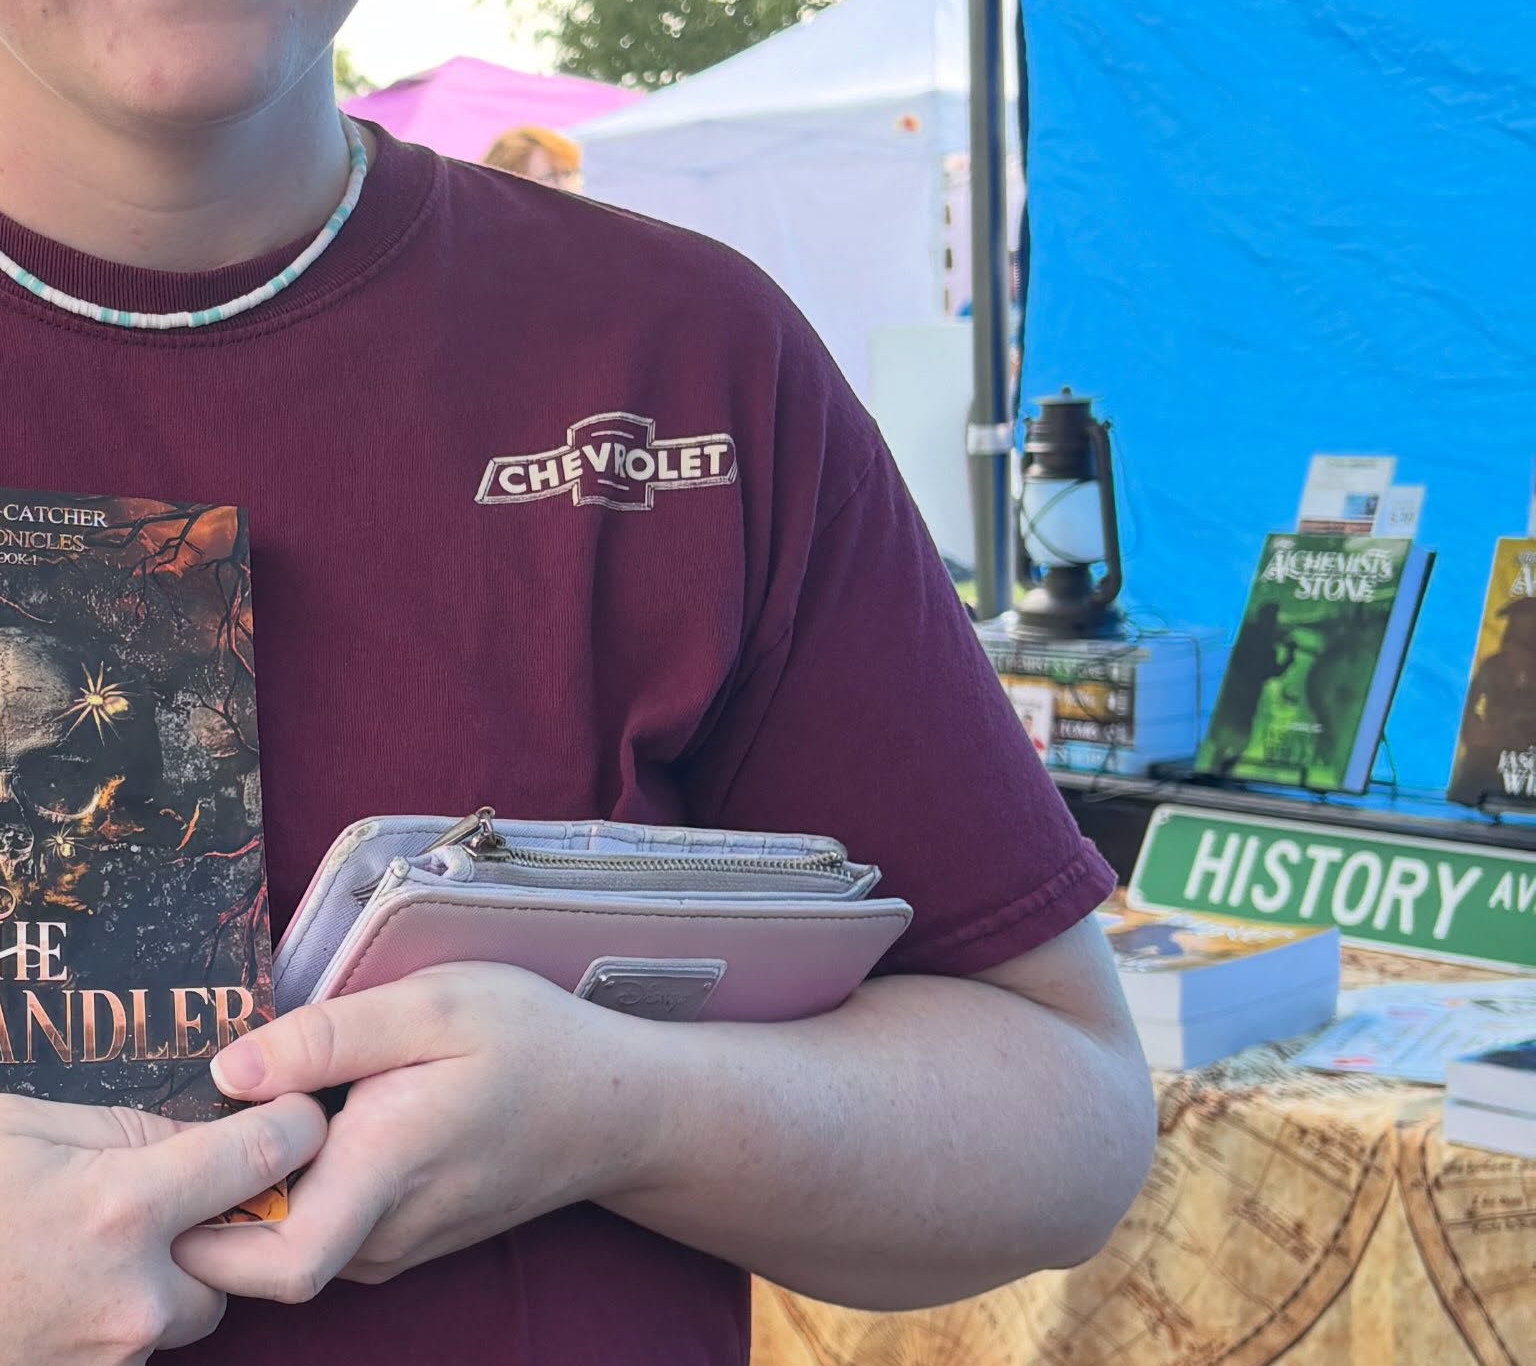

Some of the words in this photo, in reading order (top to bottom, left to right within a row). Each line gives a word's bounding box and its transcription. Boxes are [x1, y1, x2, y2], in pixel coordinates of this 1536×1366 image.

[498, 442, 728, 494] CHEVROLET
[1183, 829, 1484, 940] HISTORY
[1487, 871, 1536, 915] AV
